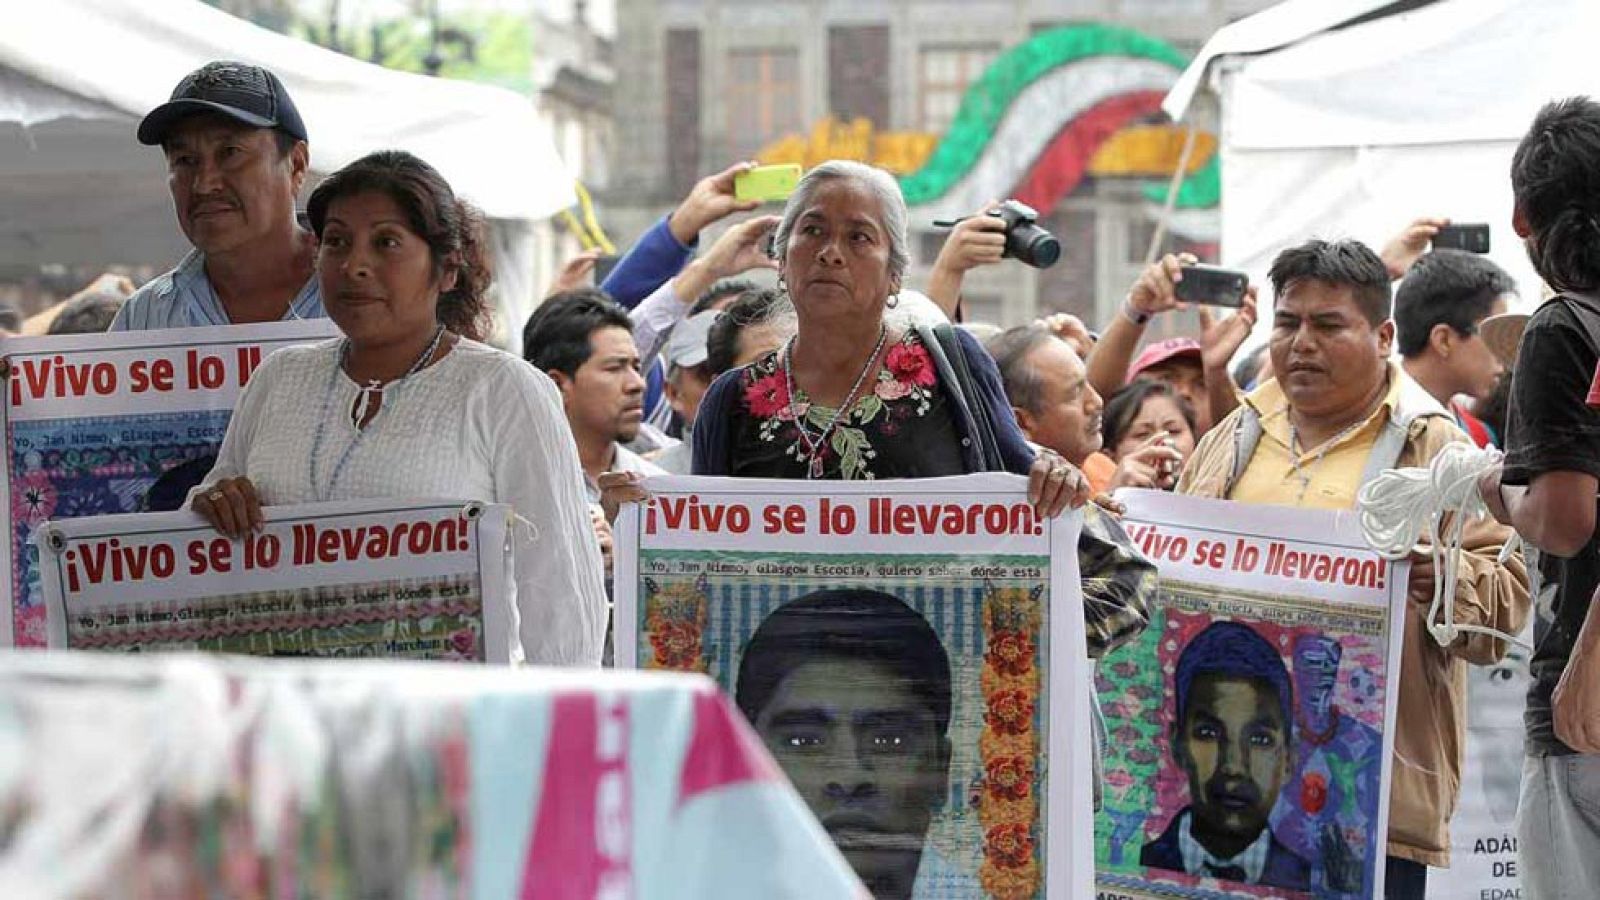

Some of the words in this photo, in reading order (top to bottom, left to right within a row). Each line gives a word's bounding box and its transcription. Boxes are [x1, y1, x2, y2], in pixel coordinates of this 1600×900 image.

[10, 356, 117, 405] ¡Vivo
[129, 361, 174, 392] se
[187, 350, 225, 390] lo
[43, 434, 65, 446] Jan
[646, 495, 750, 534] ¡Vivo
[763, 504, 806, 534] se
[819, 498, 856, 535] lo
[869, 498, 1043, 535] llevaron!
[65, 538, 175, 592] ¡Vivo
[188, 538, 232, 575] se
[244, 534, 280, 569] lo
[293, 513, 469, 566] llevaron!
[650, 561, 669, 573] Yo,
[680, 561, 700, 572] Jan
[707, 561, 748, 575] Nimmo,
[756, 562, 807, 577] Glasgow
[878, 564, 922, 579] quiero
[1193, 540, 1226, 569] se
[1231, 538, 1259, 573] lo
[1264, 542, 1386, 589] llevaron!
[1493, 862, 1516, 877] DE
